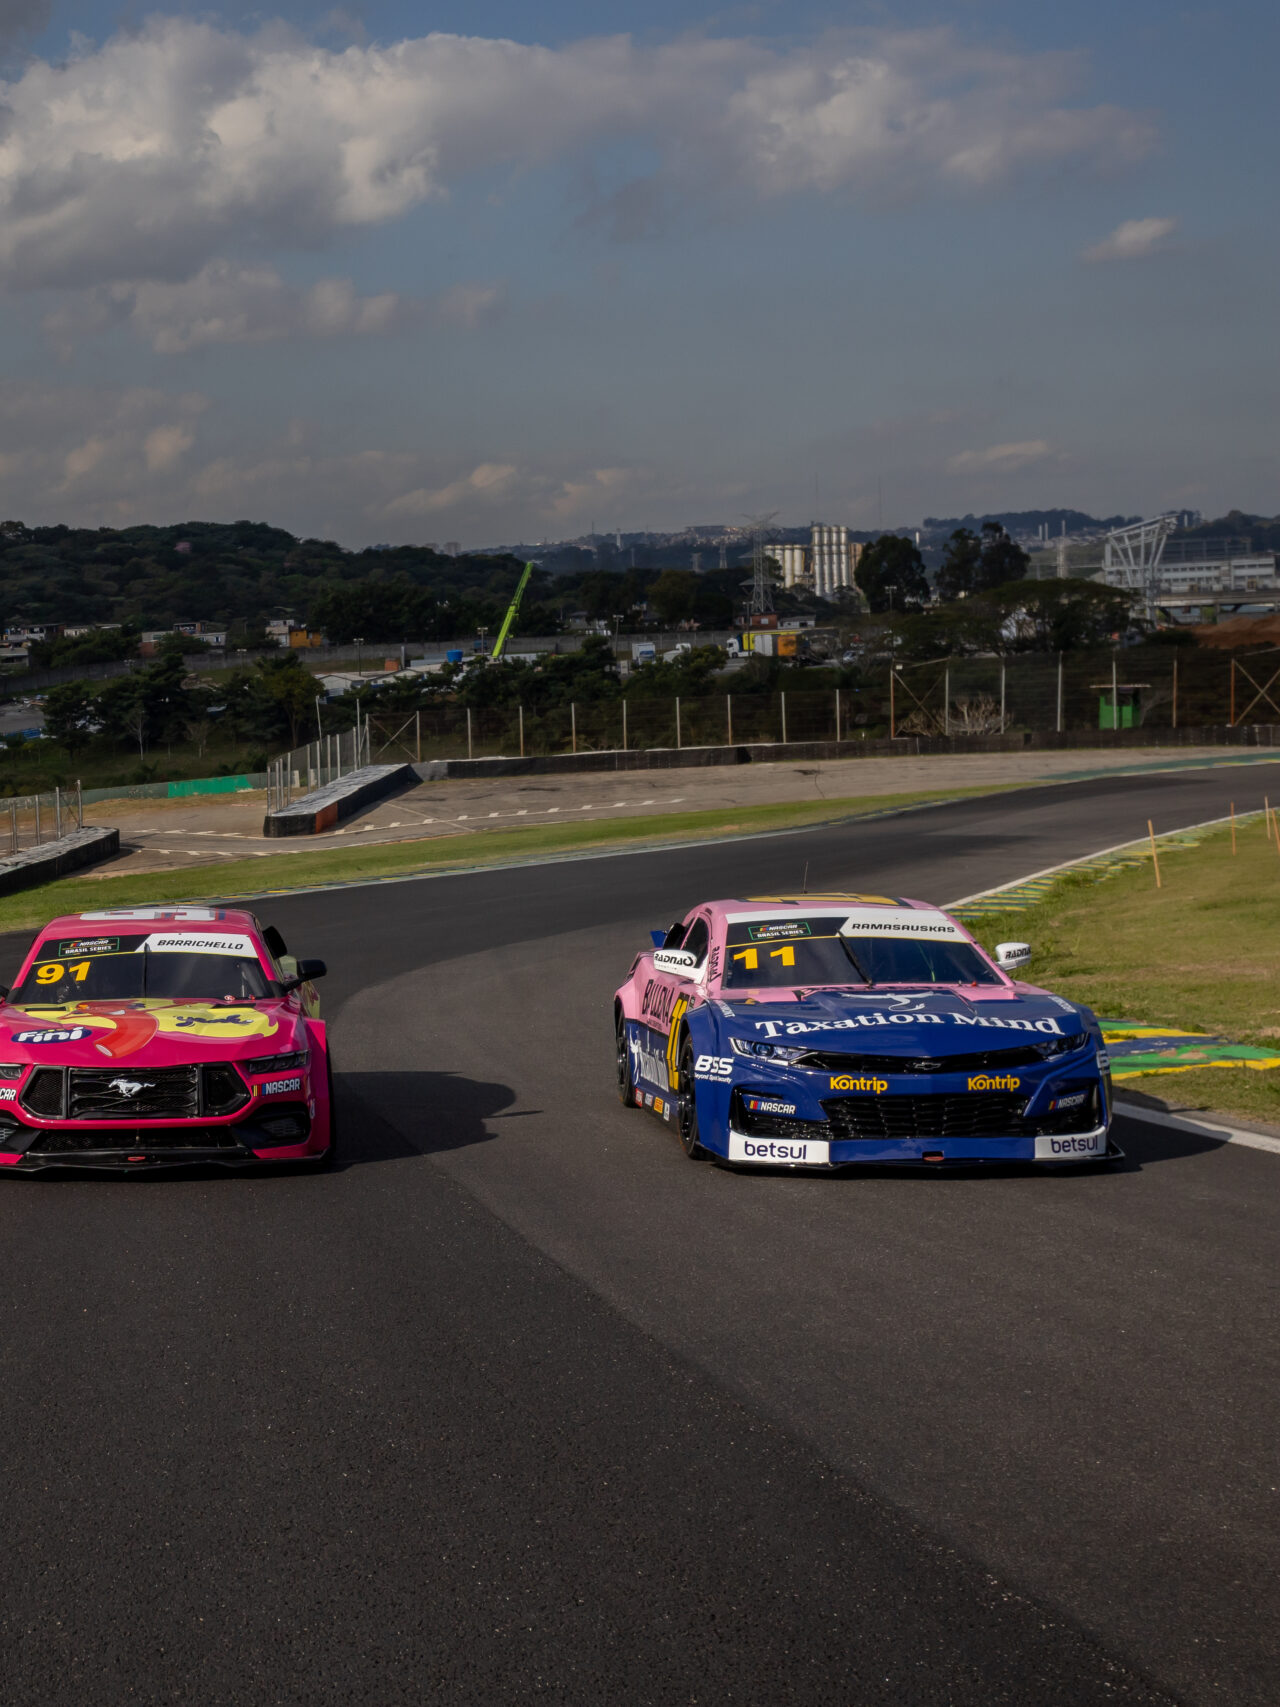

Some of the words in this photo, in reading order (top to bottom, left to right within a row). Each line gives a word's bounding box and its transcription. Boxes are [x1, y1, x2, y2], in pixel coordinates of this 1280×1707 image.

[852, 923, 955, 933] RAMASAUSKAS
[157, 939, 244, 950] BARRICHELLO
[733, 946, 795, 969] 11
[35, 961, 91, 985] 91
[755, 1011, 945, 1039] Taxation
[953, 1012, 1066, 1036] Mind
[695, 1055, 734, 1075] BSS
[266, 1078, 301, 1093] NASCAR
[830, 1075, 888, 1095] Kontrip
[968, 1074, 1020, 1092] Kontrip
[760, 1101, 796, 1115] NASCAR
[744, 1141, 807, 1160] betsul
[1051, 1137, 1098, 1153] betsul
